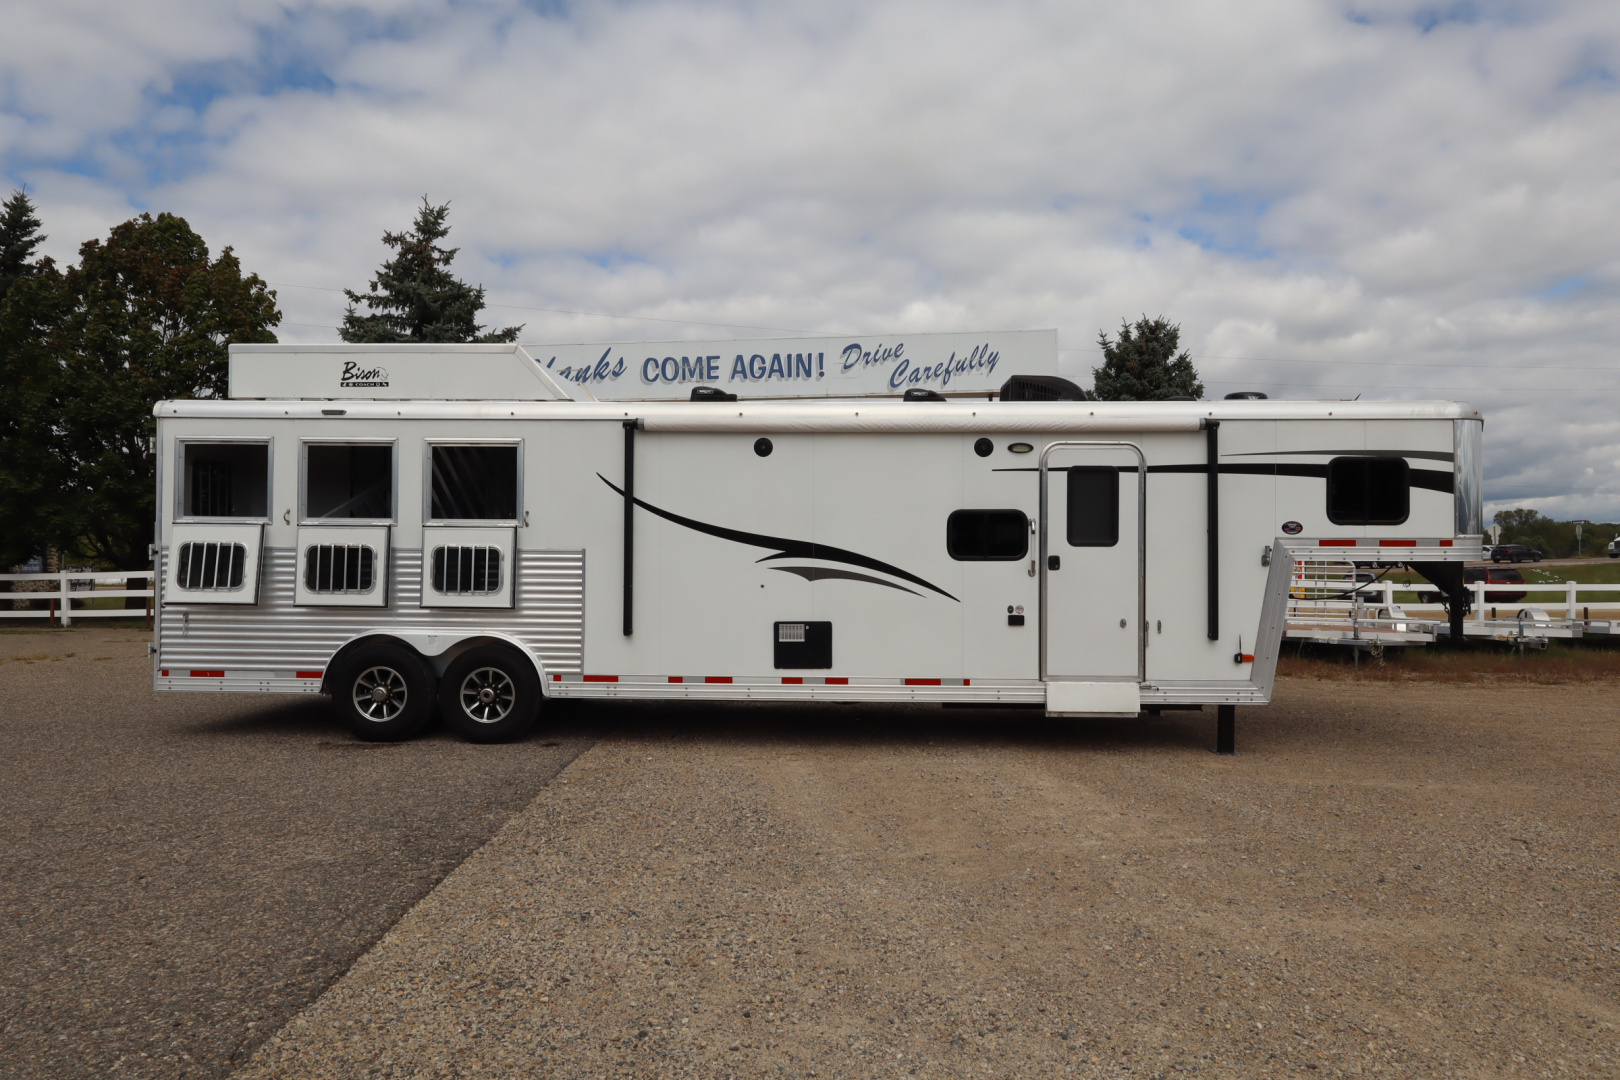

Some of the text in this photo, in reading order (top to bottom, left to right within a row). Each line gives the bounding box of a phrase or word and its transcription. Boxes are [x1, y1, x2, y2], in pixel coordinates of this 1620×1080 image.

[341, 361, 380, 381] Bison
[643, 356, 721, 383] COME
[731, 353, 825, 380] AGAIN!
[841, 343, 905, 374] Drive
[890, 343, 1001, 390] Carefully
